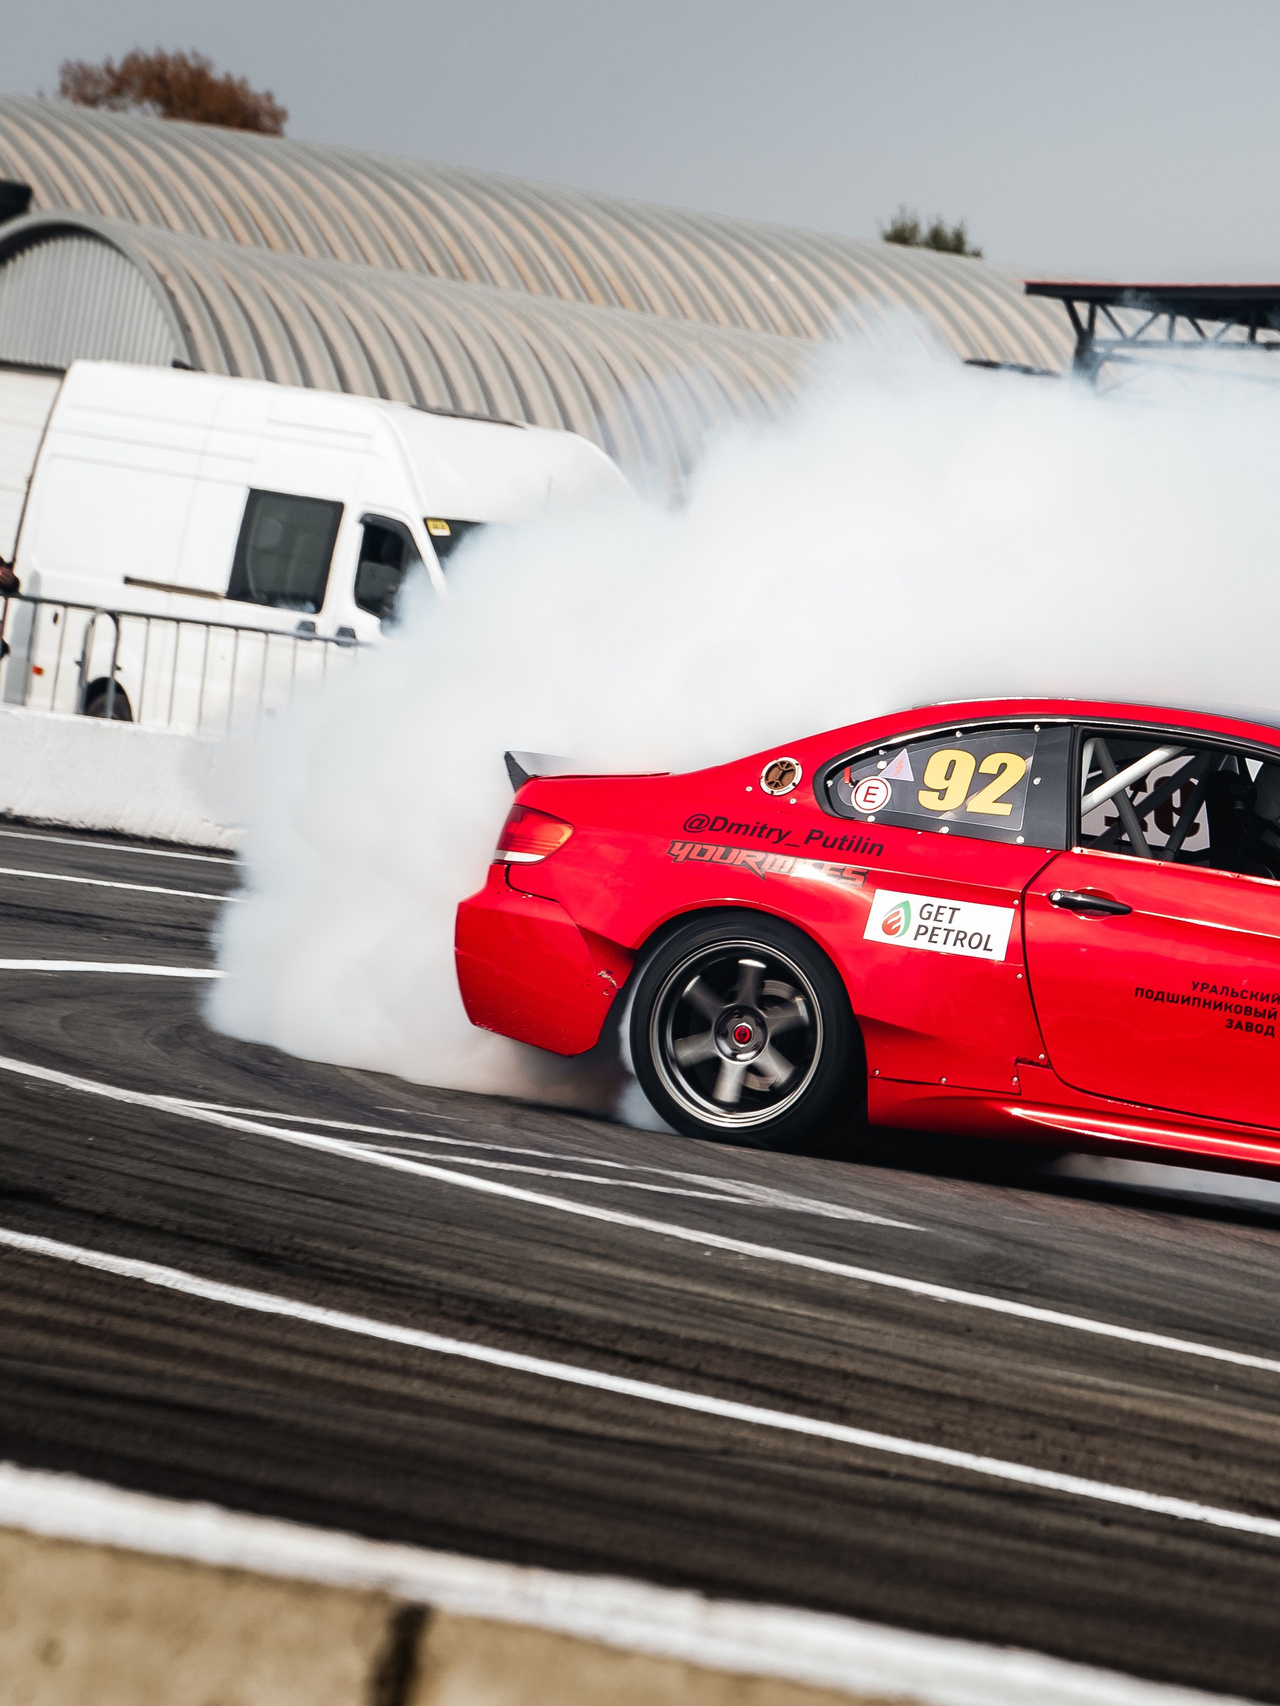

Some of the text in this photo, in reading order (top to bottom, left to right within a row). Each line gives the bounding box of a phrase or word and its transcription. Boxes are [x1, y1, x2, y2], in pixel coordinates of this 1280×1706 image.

[863, 786, 879, 803] E
[917, 749, 1027, 816] 92
[683, 814, 885, 857] @Dmitry_Putilin
[667, 840, 870, 888] YOURMES
[918, 903, 960, 924] GET
[913, 924, 994, 952] PETROL
[1134, 987, 1278, 1021] ПОДШИПНИКОВЫЙ
[1191, 981, 1280, 1005] УРАЛЬСКИЙ
[1224, 1018, 1275, 1038] ЗАВОД
